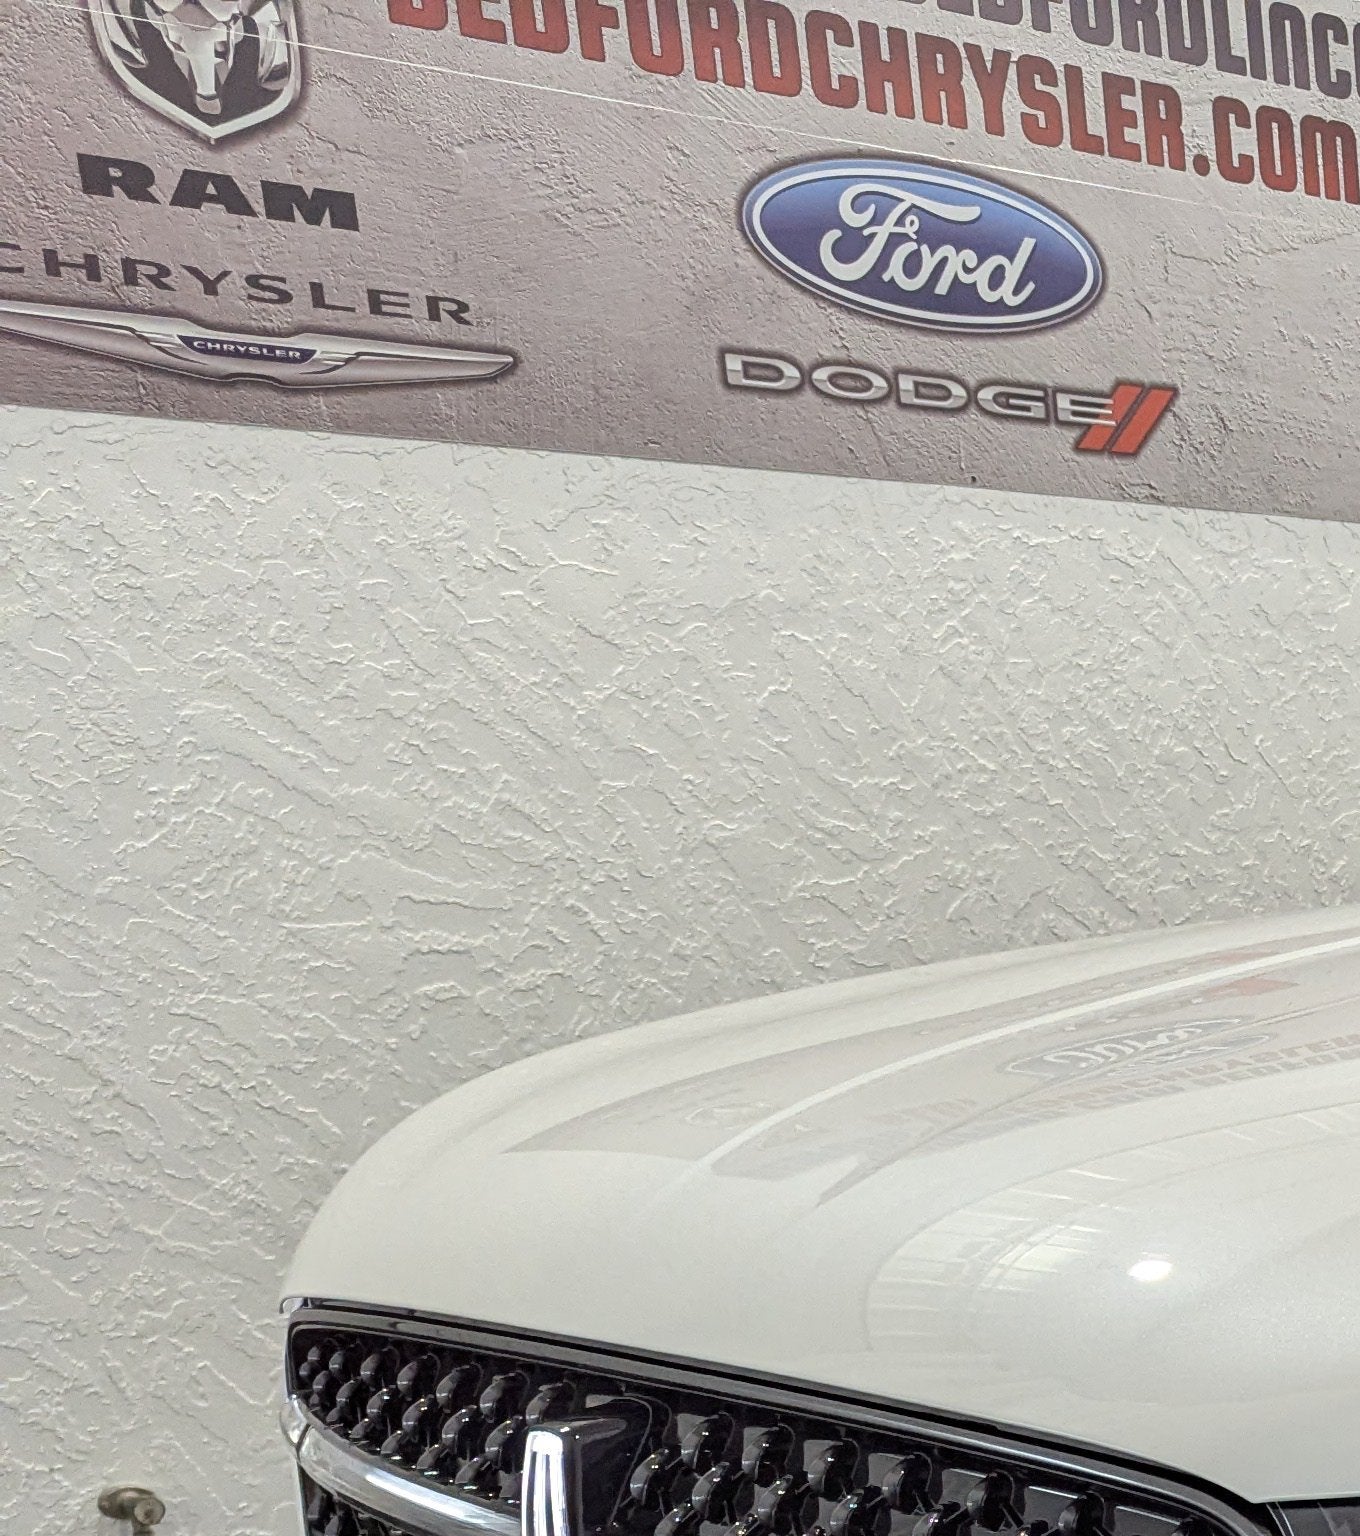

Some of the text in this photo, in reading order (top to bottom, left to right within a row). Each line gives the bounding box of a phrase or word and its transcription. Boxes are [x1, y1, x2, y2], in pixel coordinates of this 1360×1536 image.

[77, 153, 360, 232] RAM
[819, 182, 1036, 306] Ford
[193, 340, 302, 361] CHRYSLER
[724, 353, 1117, 427] DODGE
